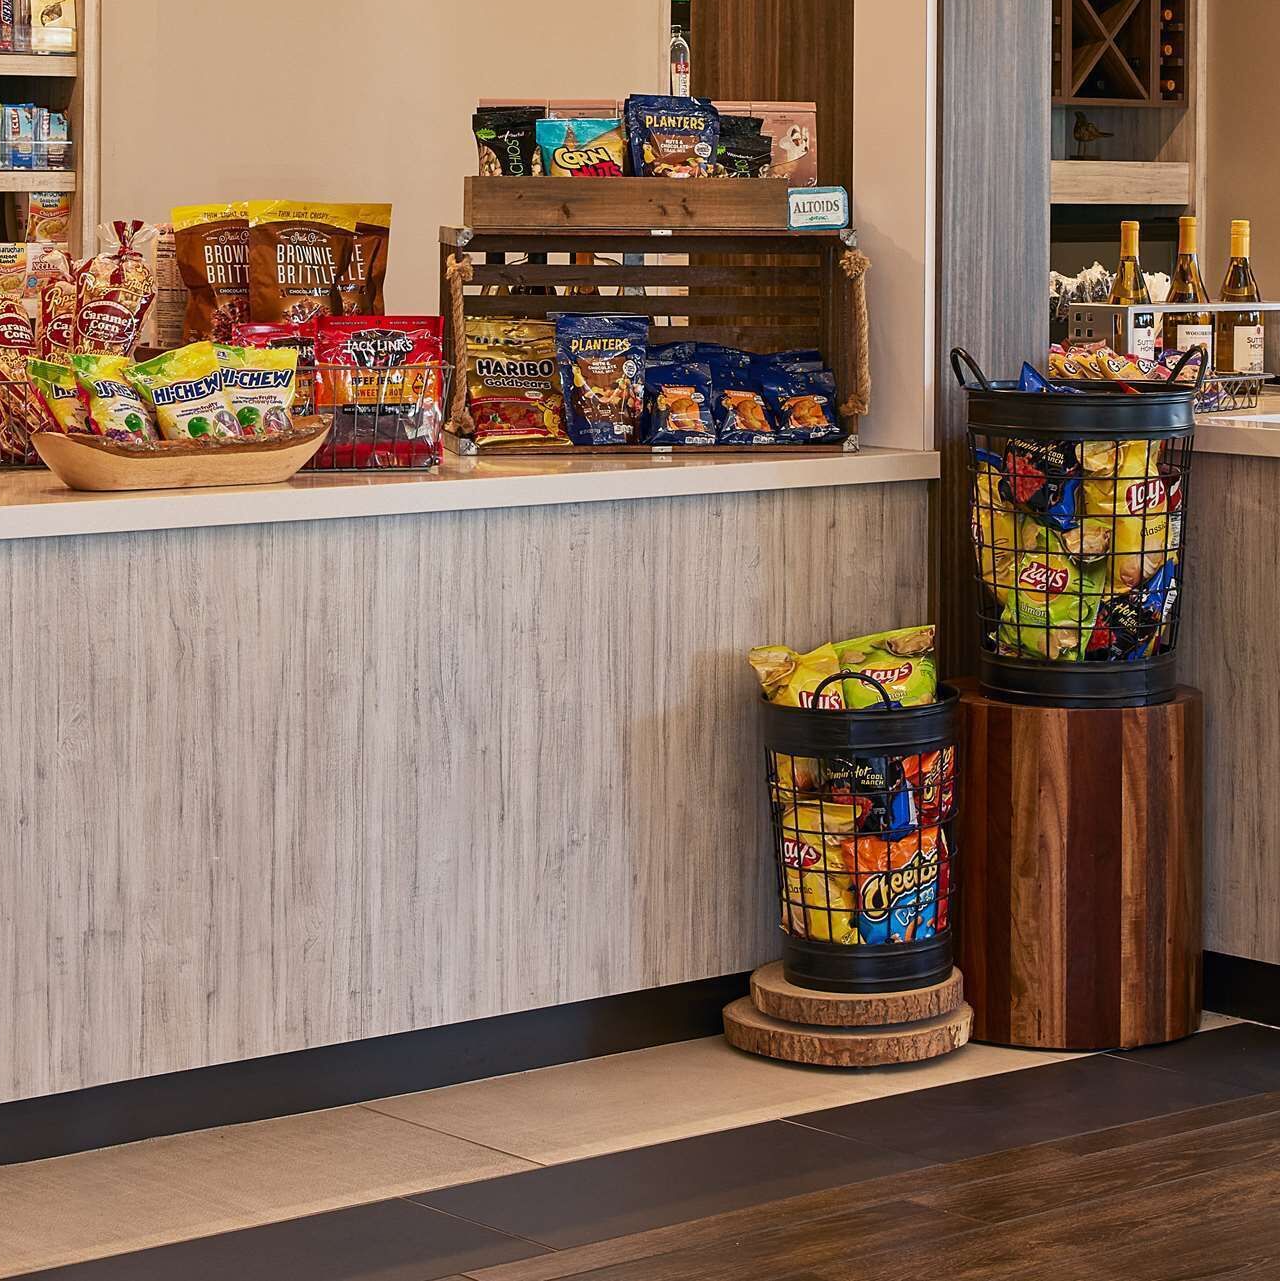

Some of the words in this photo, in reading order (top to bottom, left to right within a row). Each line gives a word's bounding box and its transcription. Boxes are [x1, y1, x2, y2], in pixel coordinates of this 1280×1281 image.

[645, 115, 705, 131] PLANTERS
[554, 147, 612, 169] CORN
[793, 200, 840, 214] ALTOIDS
[276, 244, 335, 265] BROWNIE
[89, 320, 120, 332] Corn
[4, 330, 31, 340] Corn
[342, 339, 376, 354] JACK
[377, 338, 414, 353] LINK'S
[570, 338, 632, 353] PLANTERS
[476, 359, 554, 377] HARIBO
[220, 368, 294, 389] HI-CHEW
[376, 376, 404, 385] JERY
[484, 377, 552, 389] Goldbears
[152, 372, 223, 406] HI-CHEW
